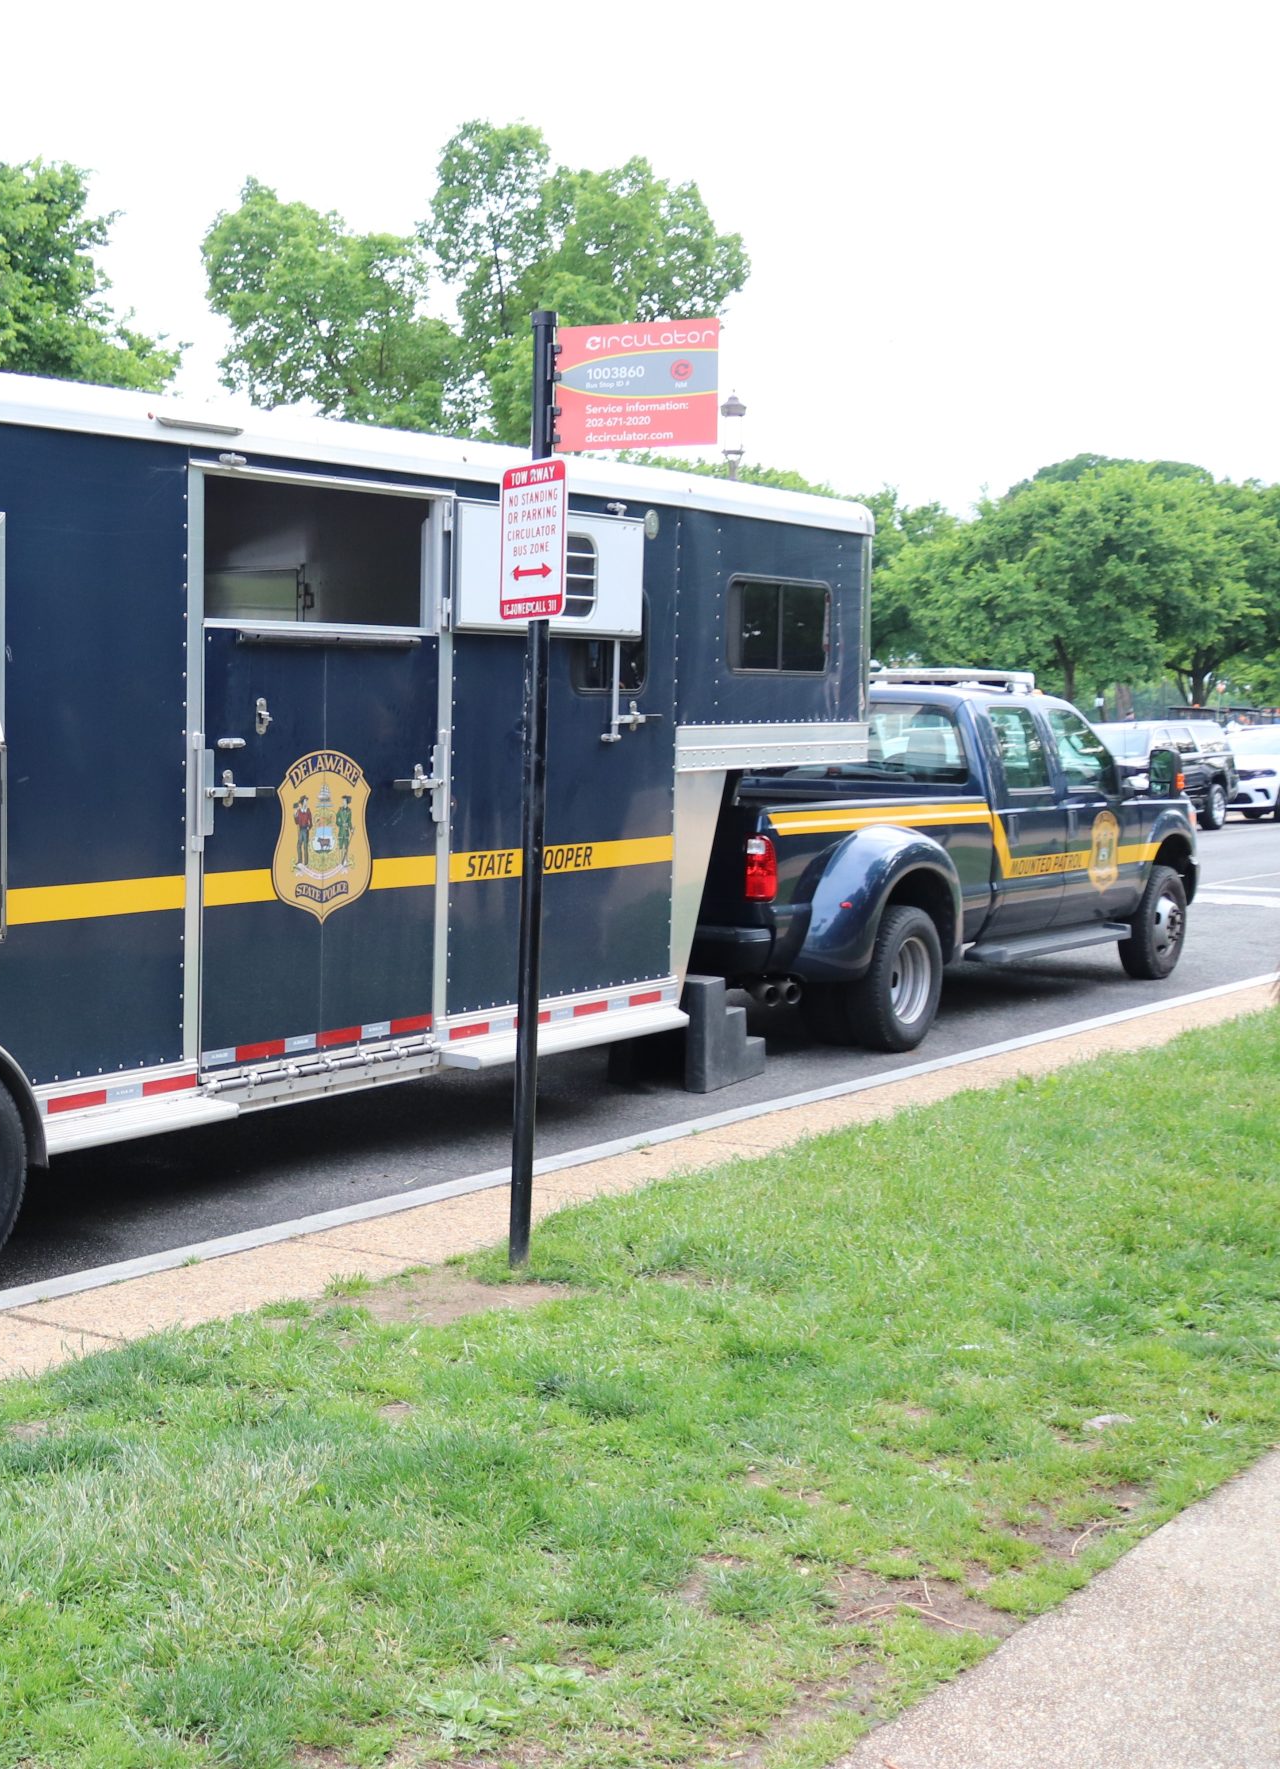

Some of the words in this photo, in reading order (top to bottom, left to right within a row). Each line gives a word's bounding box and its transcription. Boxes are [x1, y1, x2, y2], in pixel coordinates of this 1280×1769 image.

[586, 365, 645, 380] 1003860
[585, 404, 623, 414] Service
[625, 402, 689, 413] information:
[585, 416, 651, 428] 202-671-2020
[585, 431, 674, 443] dccirculator.com
[511, 470, 528, 486] TOW
[530, 465, 555, 482] AWAY
[508, 494, 519, 508] NO
[521, 488, 558, 506] STANDING
[508, 511, 519, 525] OR
[521, 505, 557, 521] PARKING
[507, 524, 556, 541] CIRCULATOR
[513, 545, 527, 557] BUS
[530, 541, 550, 554] ZONE
[532, 600, 546, 614] CALL
[548, 599, 557, 612] 311
[291, 754, 361, 785] DELAWARE
[466, 852, 514, 878] STATE
[543, 846, 593, 871] OOPER
[1010, 857, 1052, 875] MOUNTED
[296, 884, 321, 901] STATE
[322, 882, 348, 901] POLICE
